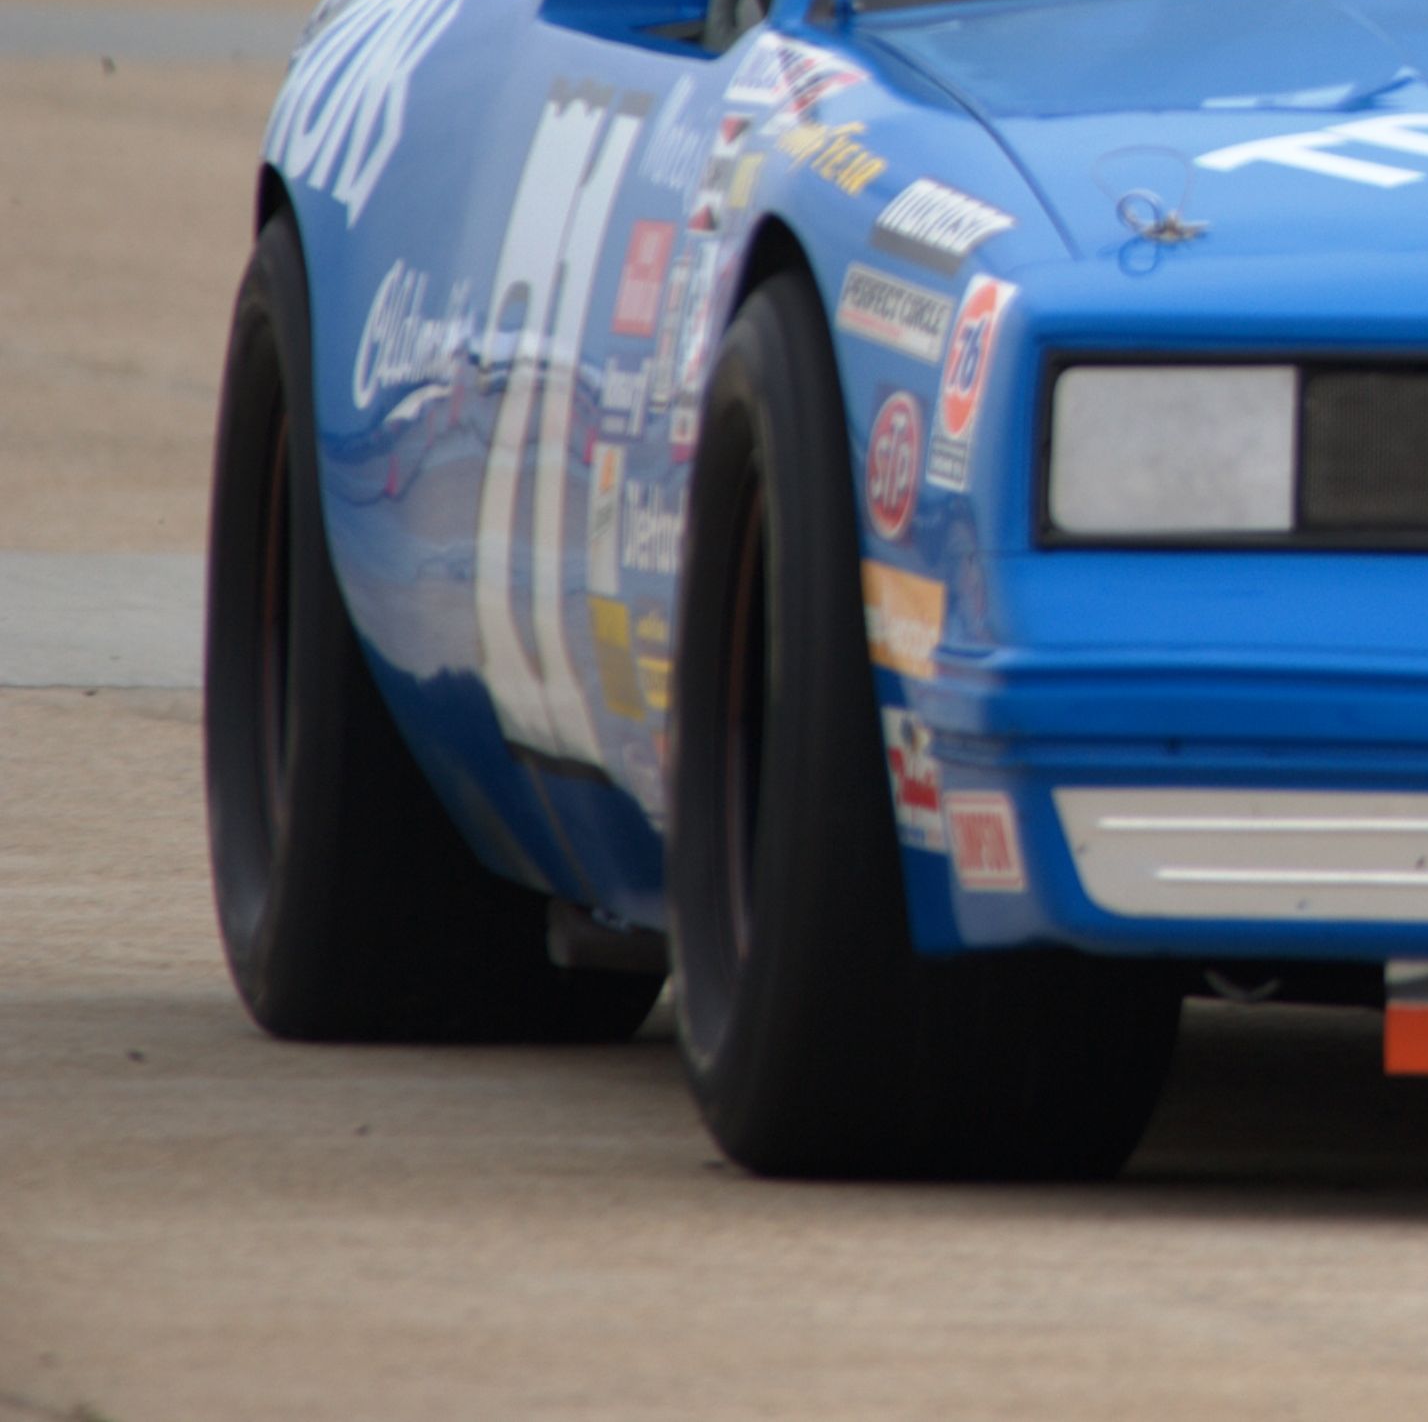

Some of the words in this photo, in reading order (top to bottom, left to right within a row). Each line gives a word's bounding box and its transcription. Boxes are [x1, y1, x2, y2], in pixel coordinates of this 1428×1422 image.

[844, 272, 902, 321] PERFECT
[897, 289, 947, 335] CIRCLE
[948, 317, 989, 394] 76
[871, 412, 911, 510] STP
